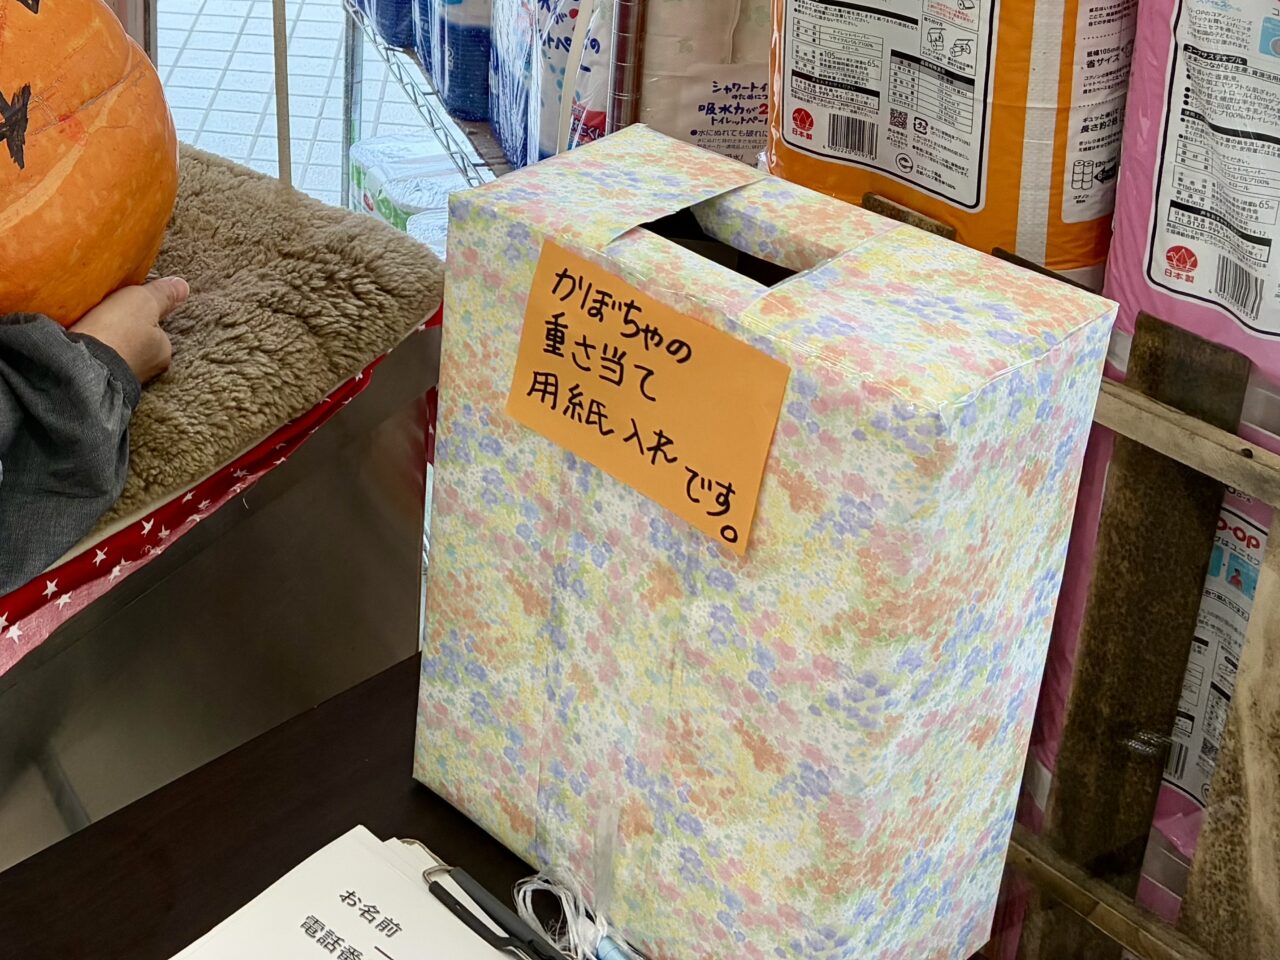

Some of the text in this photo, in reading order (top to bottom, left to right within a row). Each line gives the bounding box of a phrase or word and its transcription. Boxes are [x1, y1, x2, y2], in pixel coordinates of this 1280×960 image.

[1164, 268, 1195, 284] 日本製
[551, 267, 692, 364] かぼちゃの
[543, 311, 657, 402] 重さ当て
[339, 888, 405, 938] お名前
